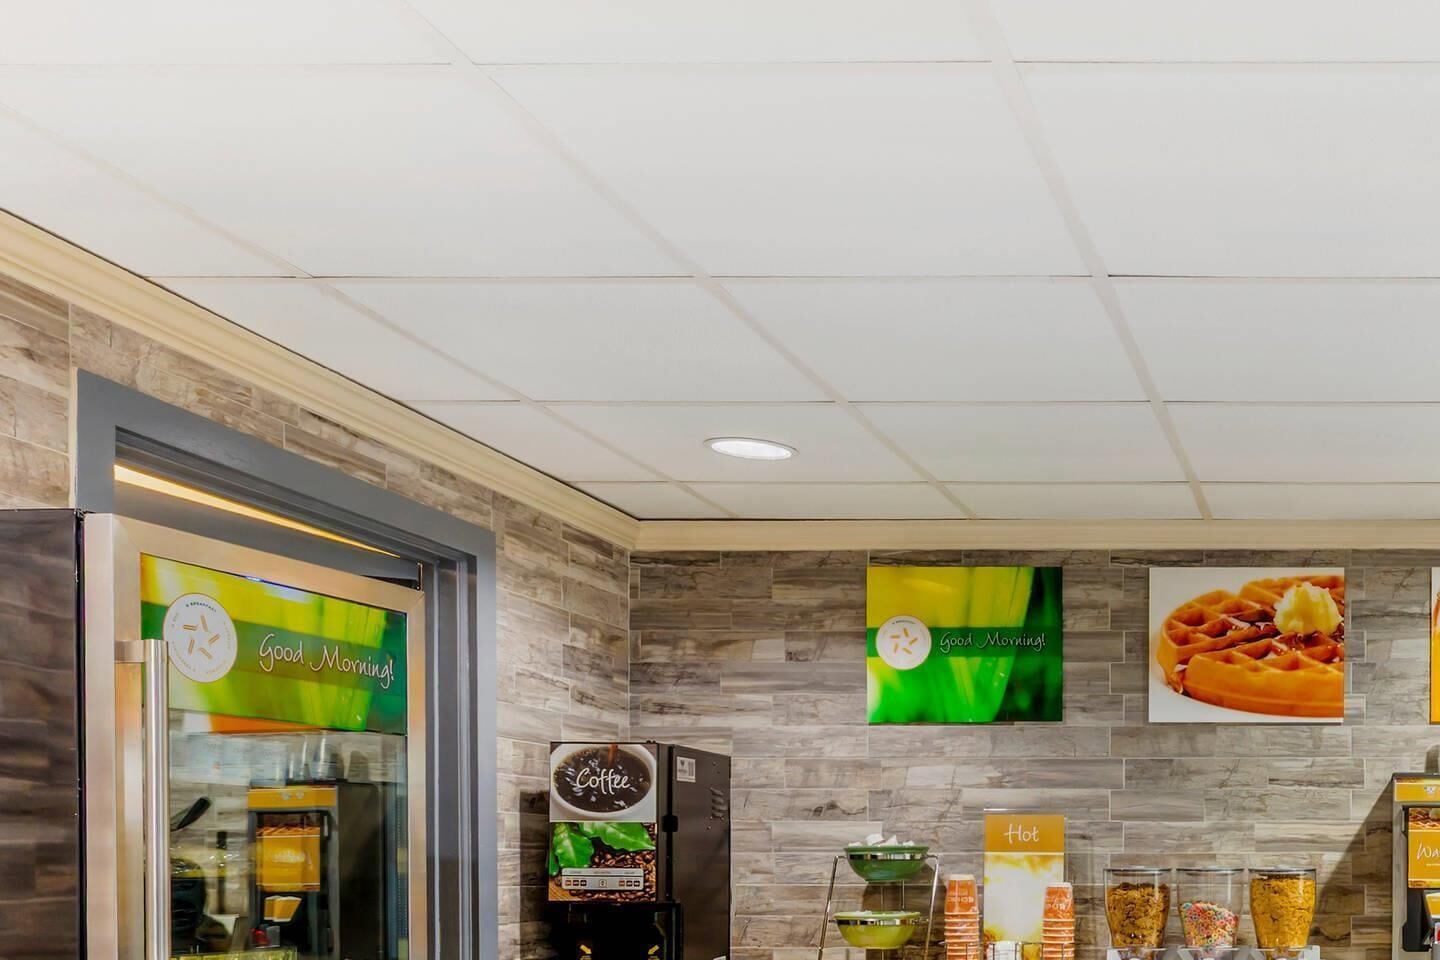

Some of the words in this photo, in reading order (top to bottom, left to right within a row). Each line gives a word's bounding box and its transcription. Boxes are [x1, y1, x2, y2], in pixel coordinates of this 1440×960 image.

[940, 631, 972, 654] Good
[976, 631, 1046, 652] Morning!
[258, 633, 305, 672] Good
[309, 644, 394, 689] Morning!
[576, 767, 631, 795] Coffee
[1003, 823, 1040, 844] Hot
